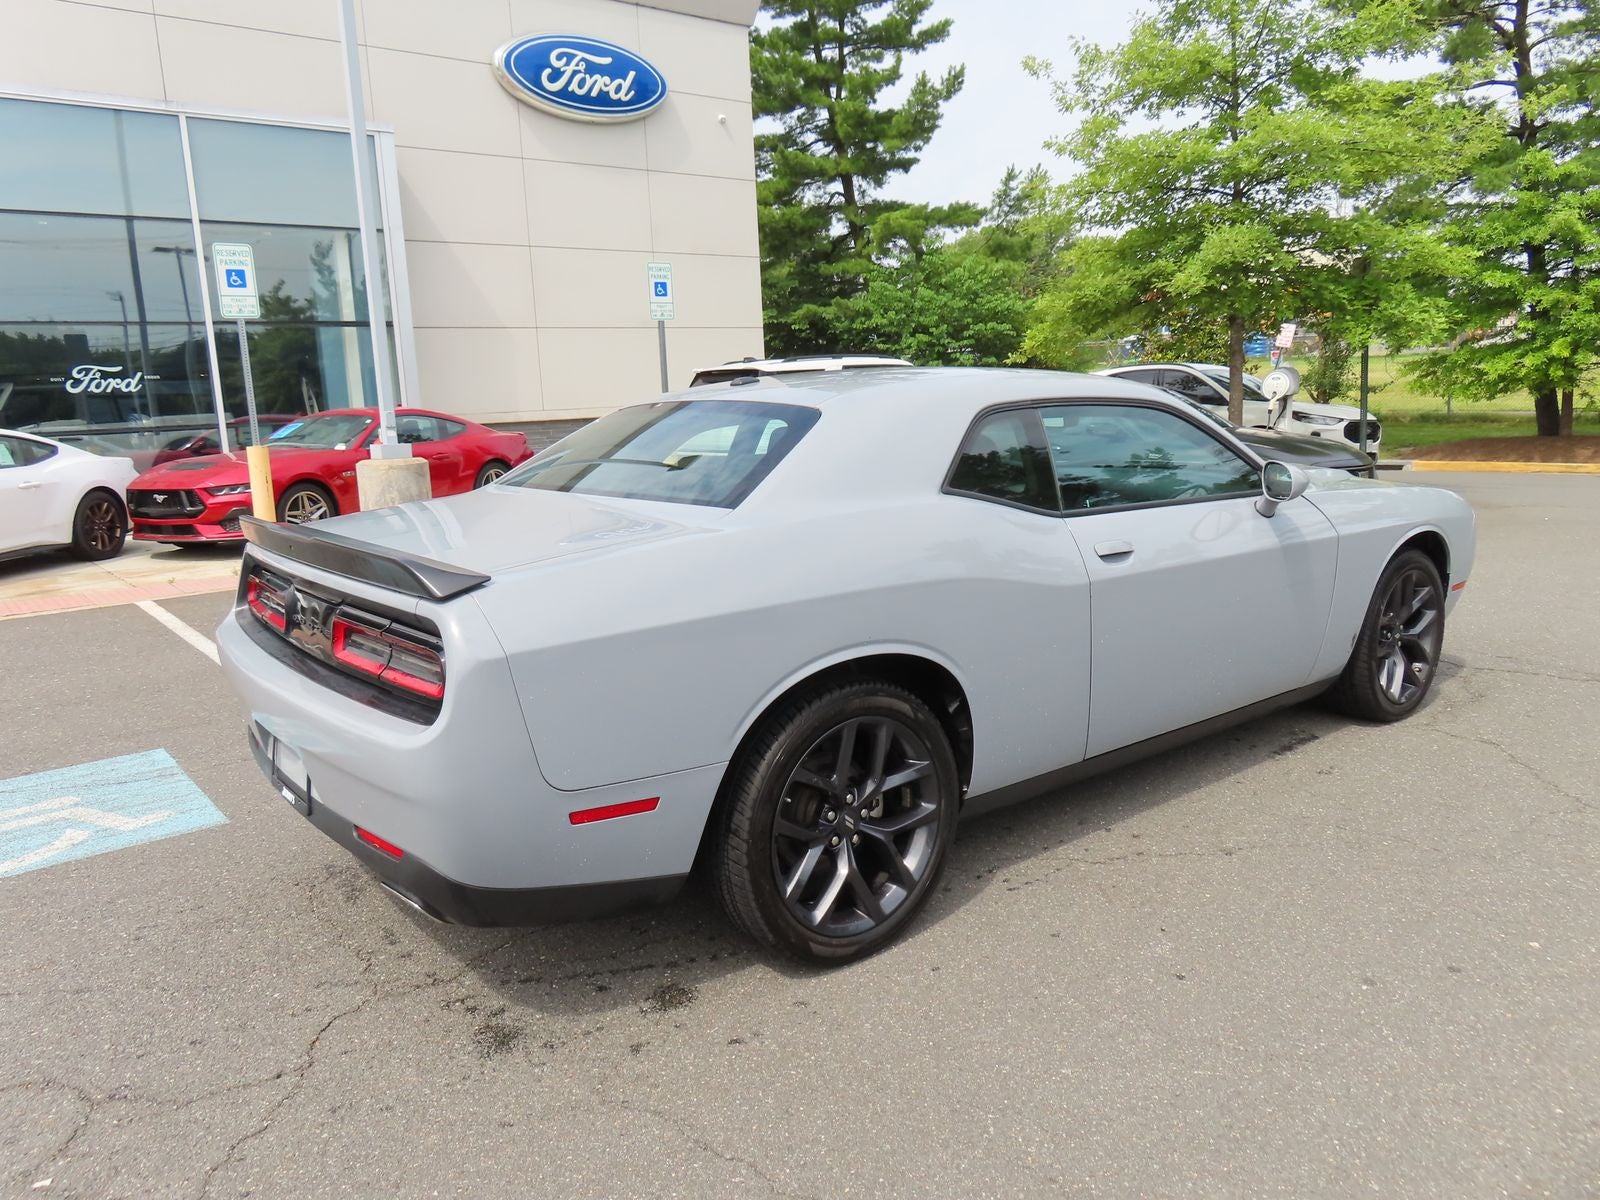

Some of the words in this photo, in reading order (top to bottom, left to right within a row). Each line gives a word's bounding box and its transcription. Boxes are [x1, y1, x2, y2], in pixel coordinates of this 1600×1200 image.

[541, 47, 636, 102] Ford
[216, 249, 249, 257] RESERVED
[65, 365, 142, 394] Ford
